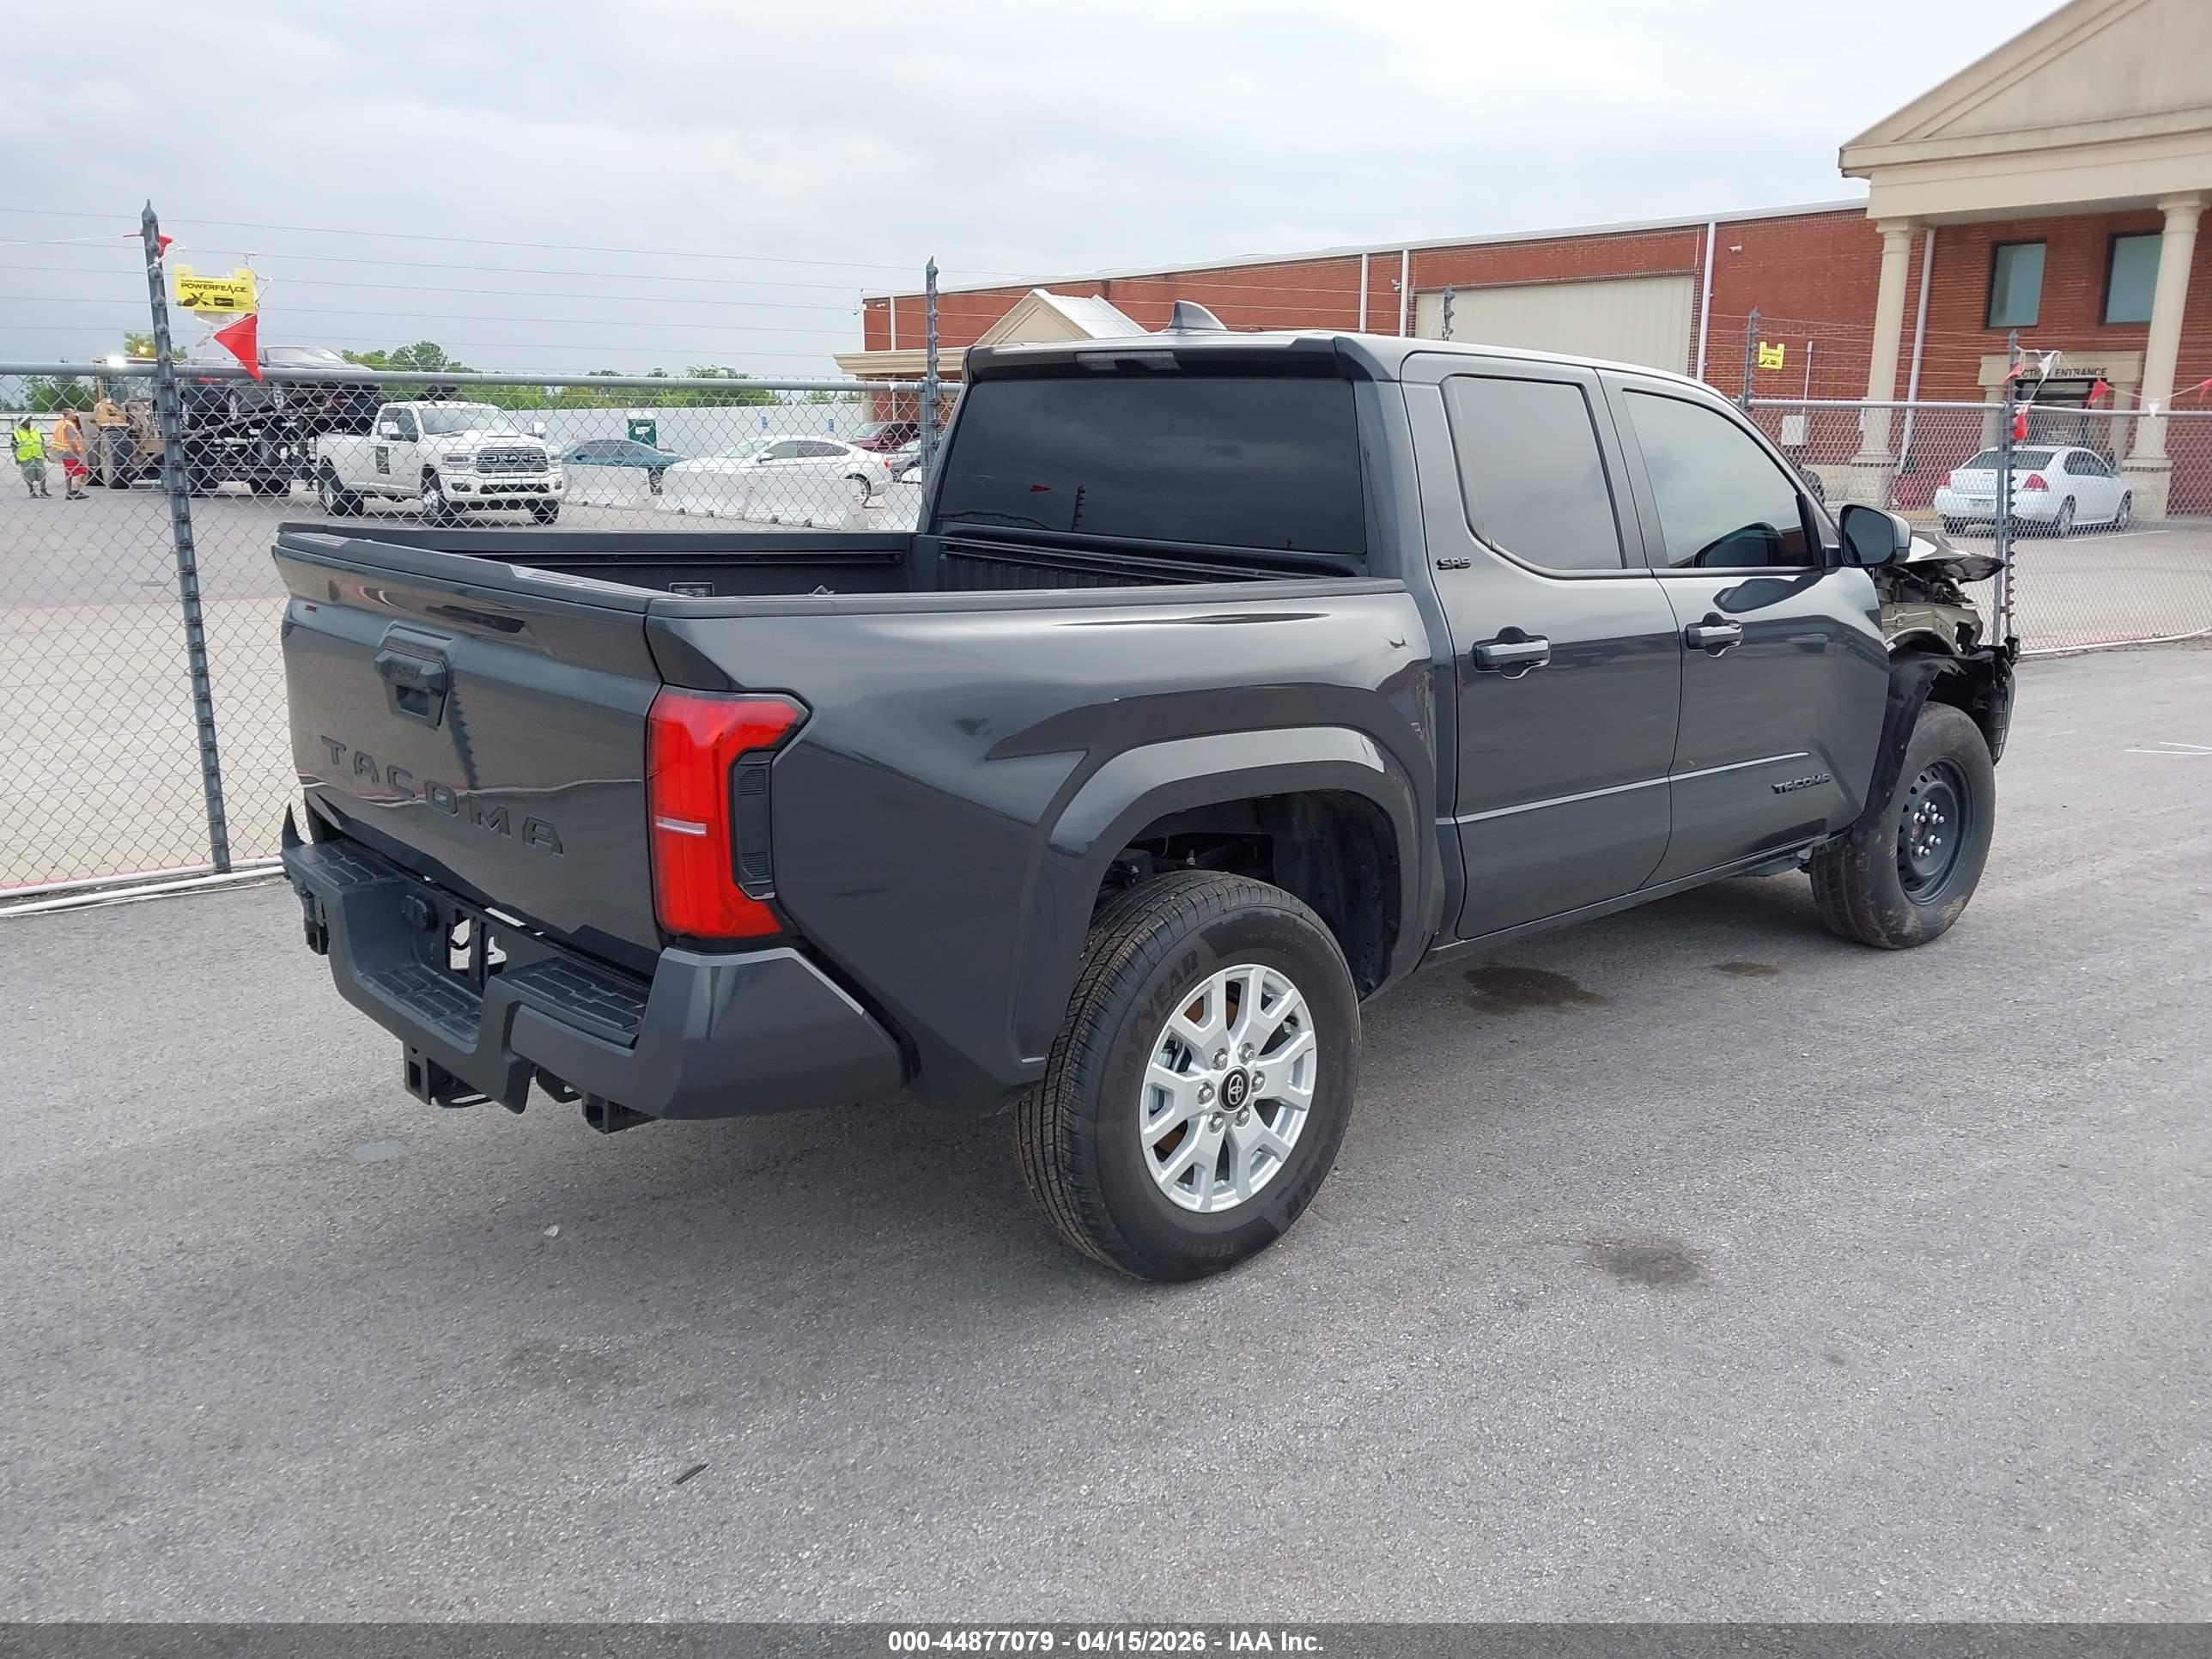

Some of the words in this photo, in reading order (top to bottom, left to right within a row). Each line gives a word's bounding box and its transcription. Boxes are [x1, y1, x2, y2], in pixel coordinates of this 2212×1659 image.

[2054, 368, 2108, 378] ENTRANCE
[1436, 557, 1472, 570] SR5
[1771, 772, 1831, 794] TACOMA
[320, 734, 564, 857] TACOMA
